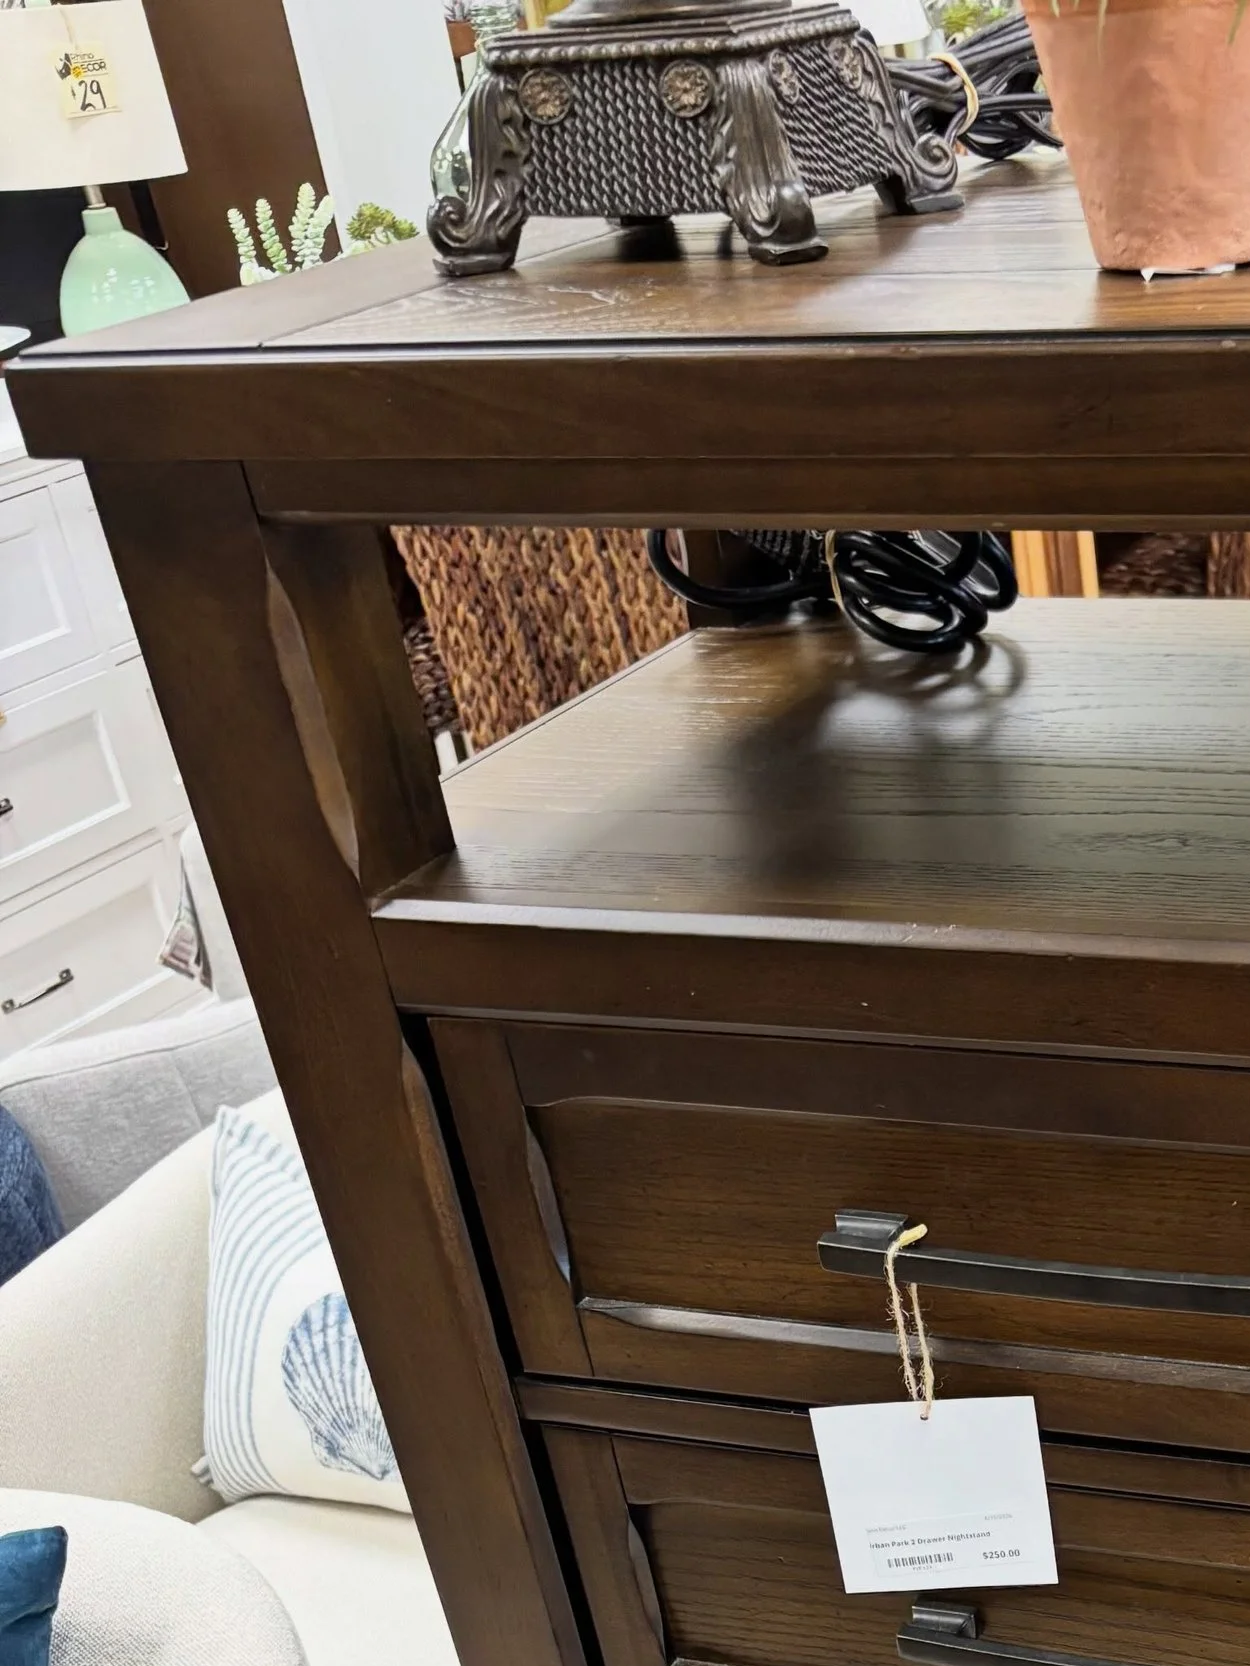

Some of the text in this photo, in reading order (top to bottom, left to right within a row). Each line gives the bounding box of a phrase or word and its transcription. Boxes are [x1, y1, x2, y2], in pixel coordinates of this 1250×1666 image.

[73, 61, 107, 74] ECOR
[891, 1540, 910, 1548] Park
[917, 1535, 946, 1545] Drawer
[947, 1531, 991, 1542] Nightstand
[982, 1549, 1021, 1560] $250.00
